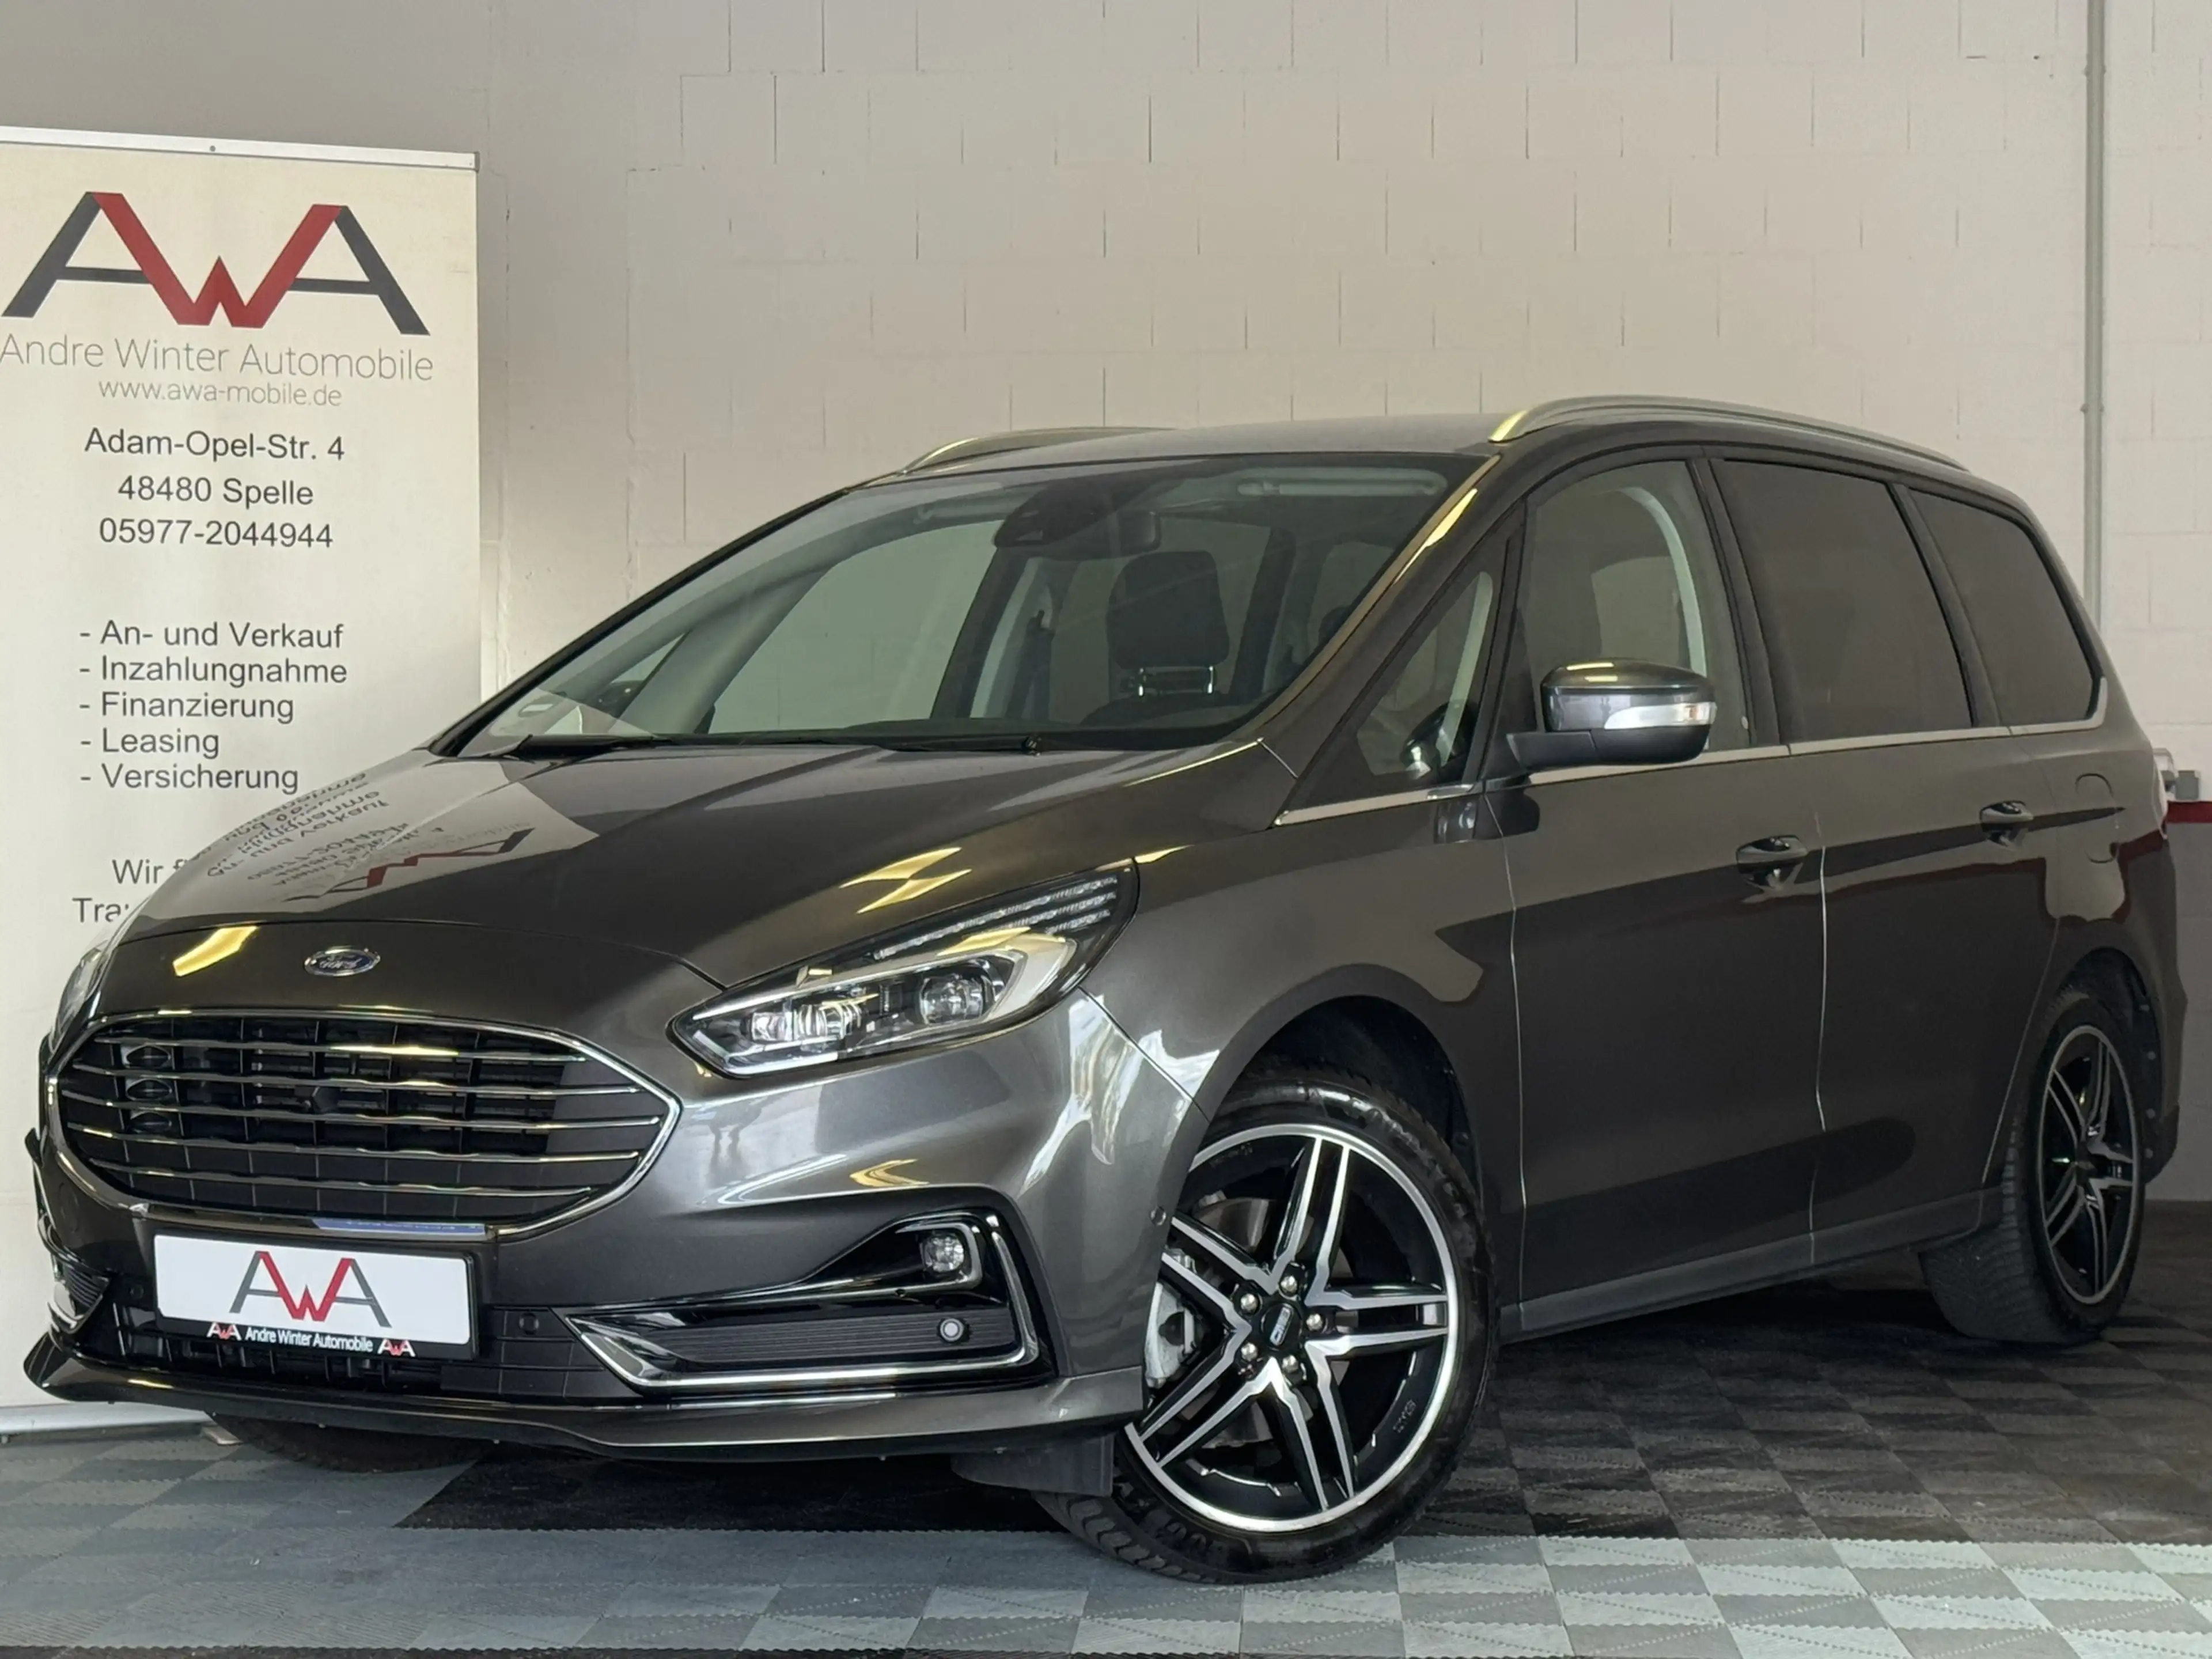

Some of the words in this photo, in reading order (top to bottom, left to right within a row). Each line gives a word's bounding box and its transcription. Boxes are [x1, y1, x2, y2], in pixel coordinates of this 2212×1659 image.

[1, 191, 430, 336] AWA
[0, 333, 104, 368] Andre
[115, 338, 229, 372] Winter
[240, 344, 434, 381] Automobile
[99, 380, 342, 407] www.awa-mobile.de
[84, 427, 317, 463] Adam-Opel-Str.
[327, 436, 345, 461] 4
[118, 475, 212, 502] 48480
[222, 478, 313, 510] Spelle
[99, 517, 334, 548] 05977-2044944
[100, 620, 153, 646] An-
[164, 622, 218, 647] und
[229, 622, 344, 649] Verkauf
[102, 655, 347, 688] Inzahlungnahme
[102, 691, 294, 724] Finanzierung
[102, 728, 219, 759] Leasing
[101, 763, 299, 794] Versicherung
[112, 858, 164, 885] Wir
[71, 897, 129, 923] Tra
[228, 1251, 392, 1328] AWA
[207, 1322, 242, 1341] AWA
[244, 1327, 276, 1343] Andre
[278, 1329, 312, 1346] Winter
[312, 1332, 374, 1353] Automobile
[377, 1338, 416, 1357] AWA
